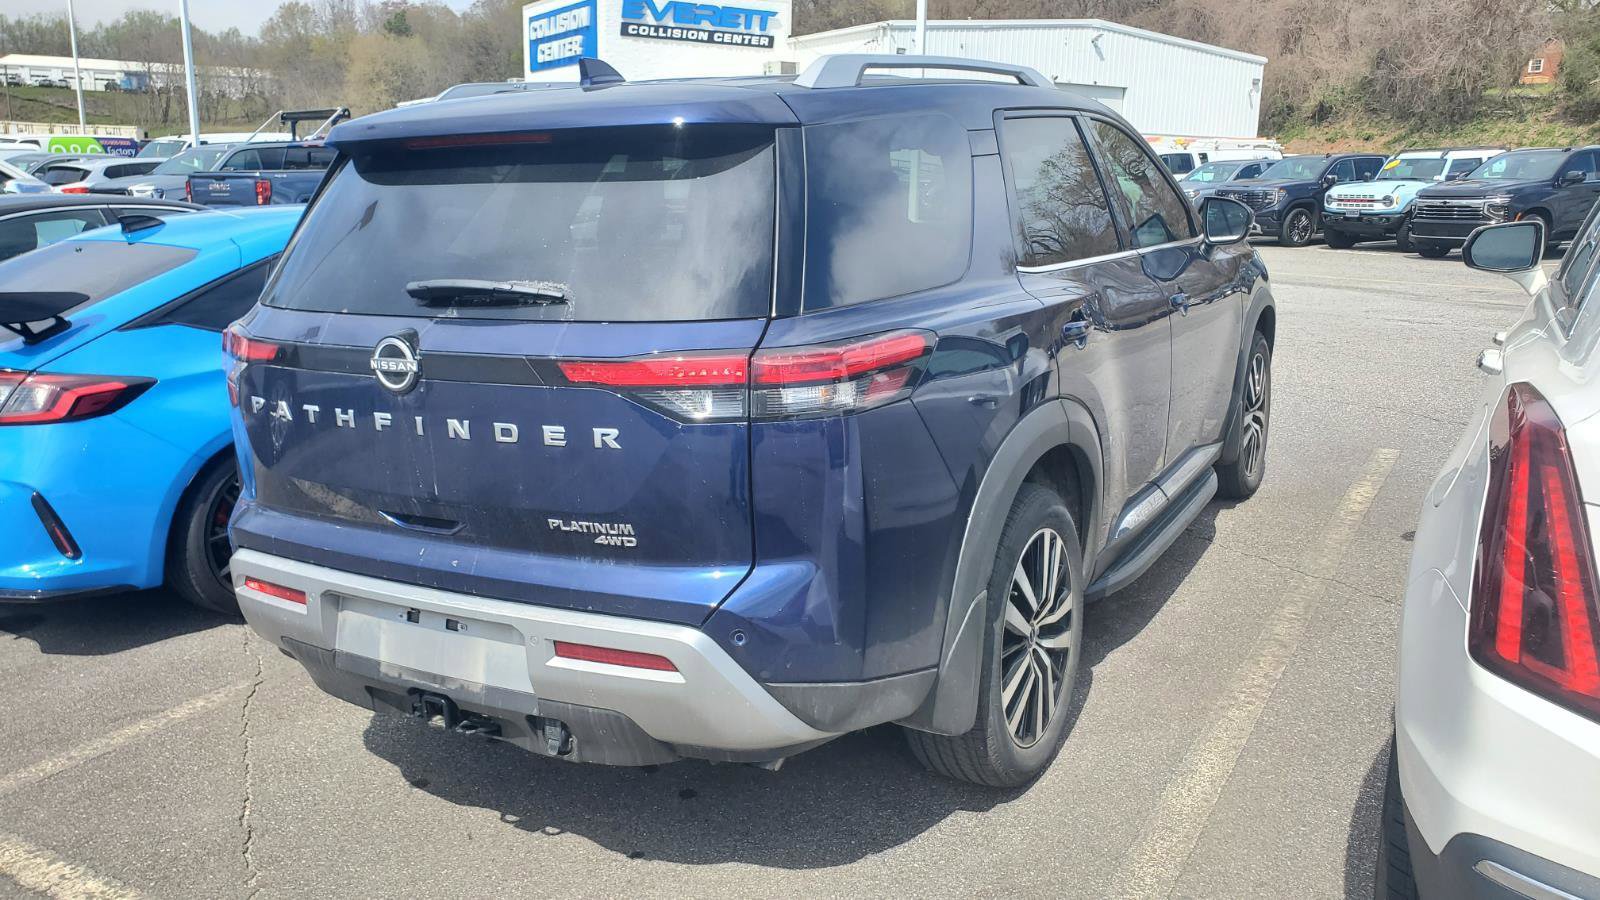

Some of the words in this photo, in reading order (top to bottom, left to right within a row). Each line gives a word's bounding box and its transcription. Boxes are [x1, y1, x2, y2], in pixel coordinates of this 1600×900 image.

[529, 6, 591, 40] COLLISION
[621, 0, 778, 32] EVERETT
[627, 24, 709, 41] COLLISION
[713, 32, 770, 47] CENTER
[537, 35, 583, 63] CENTER
[370, 359, 417, 371] NISSAN
[251, 395, 622, 449] PATHFINDER
[547, 518, 635, 536] PLATINUM
[594, 535, 638, 547] 4WD
